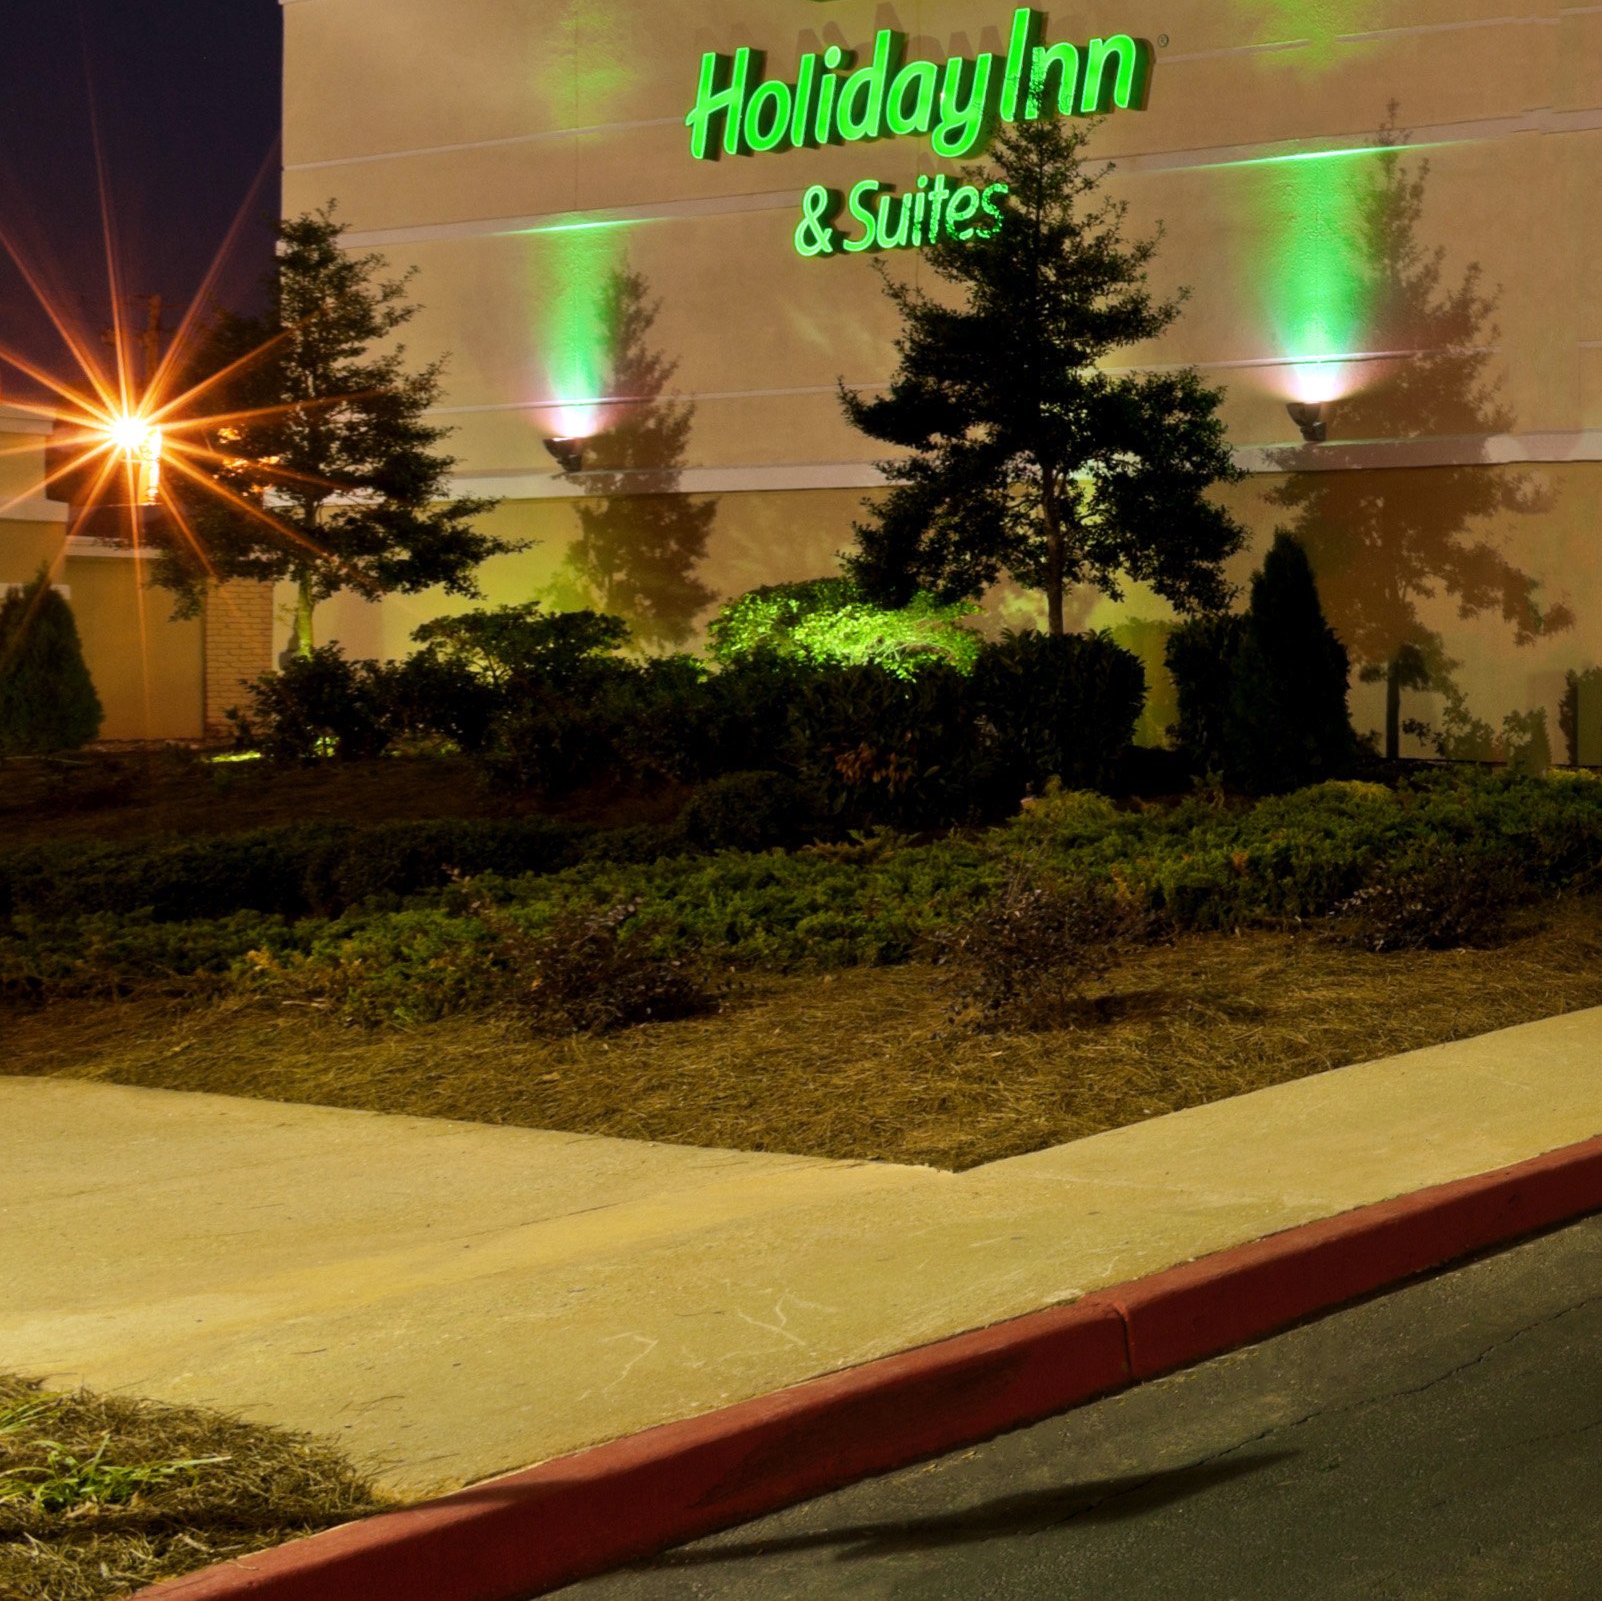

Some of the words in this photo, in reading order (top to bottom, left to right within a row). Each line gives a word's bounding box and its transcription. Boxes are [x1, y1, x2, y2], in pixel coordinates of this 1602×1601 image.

[685, 29, 992, 159] Holiday
[999, 7, 1137, 123] Inn
[794, 185, 834, 257] &
[842, 173, 1009, 252] Suites
